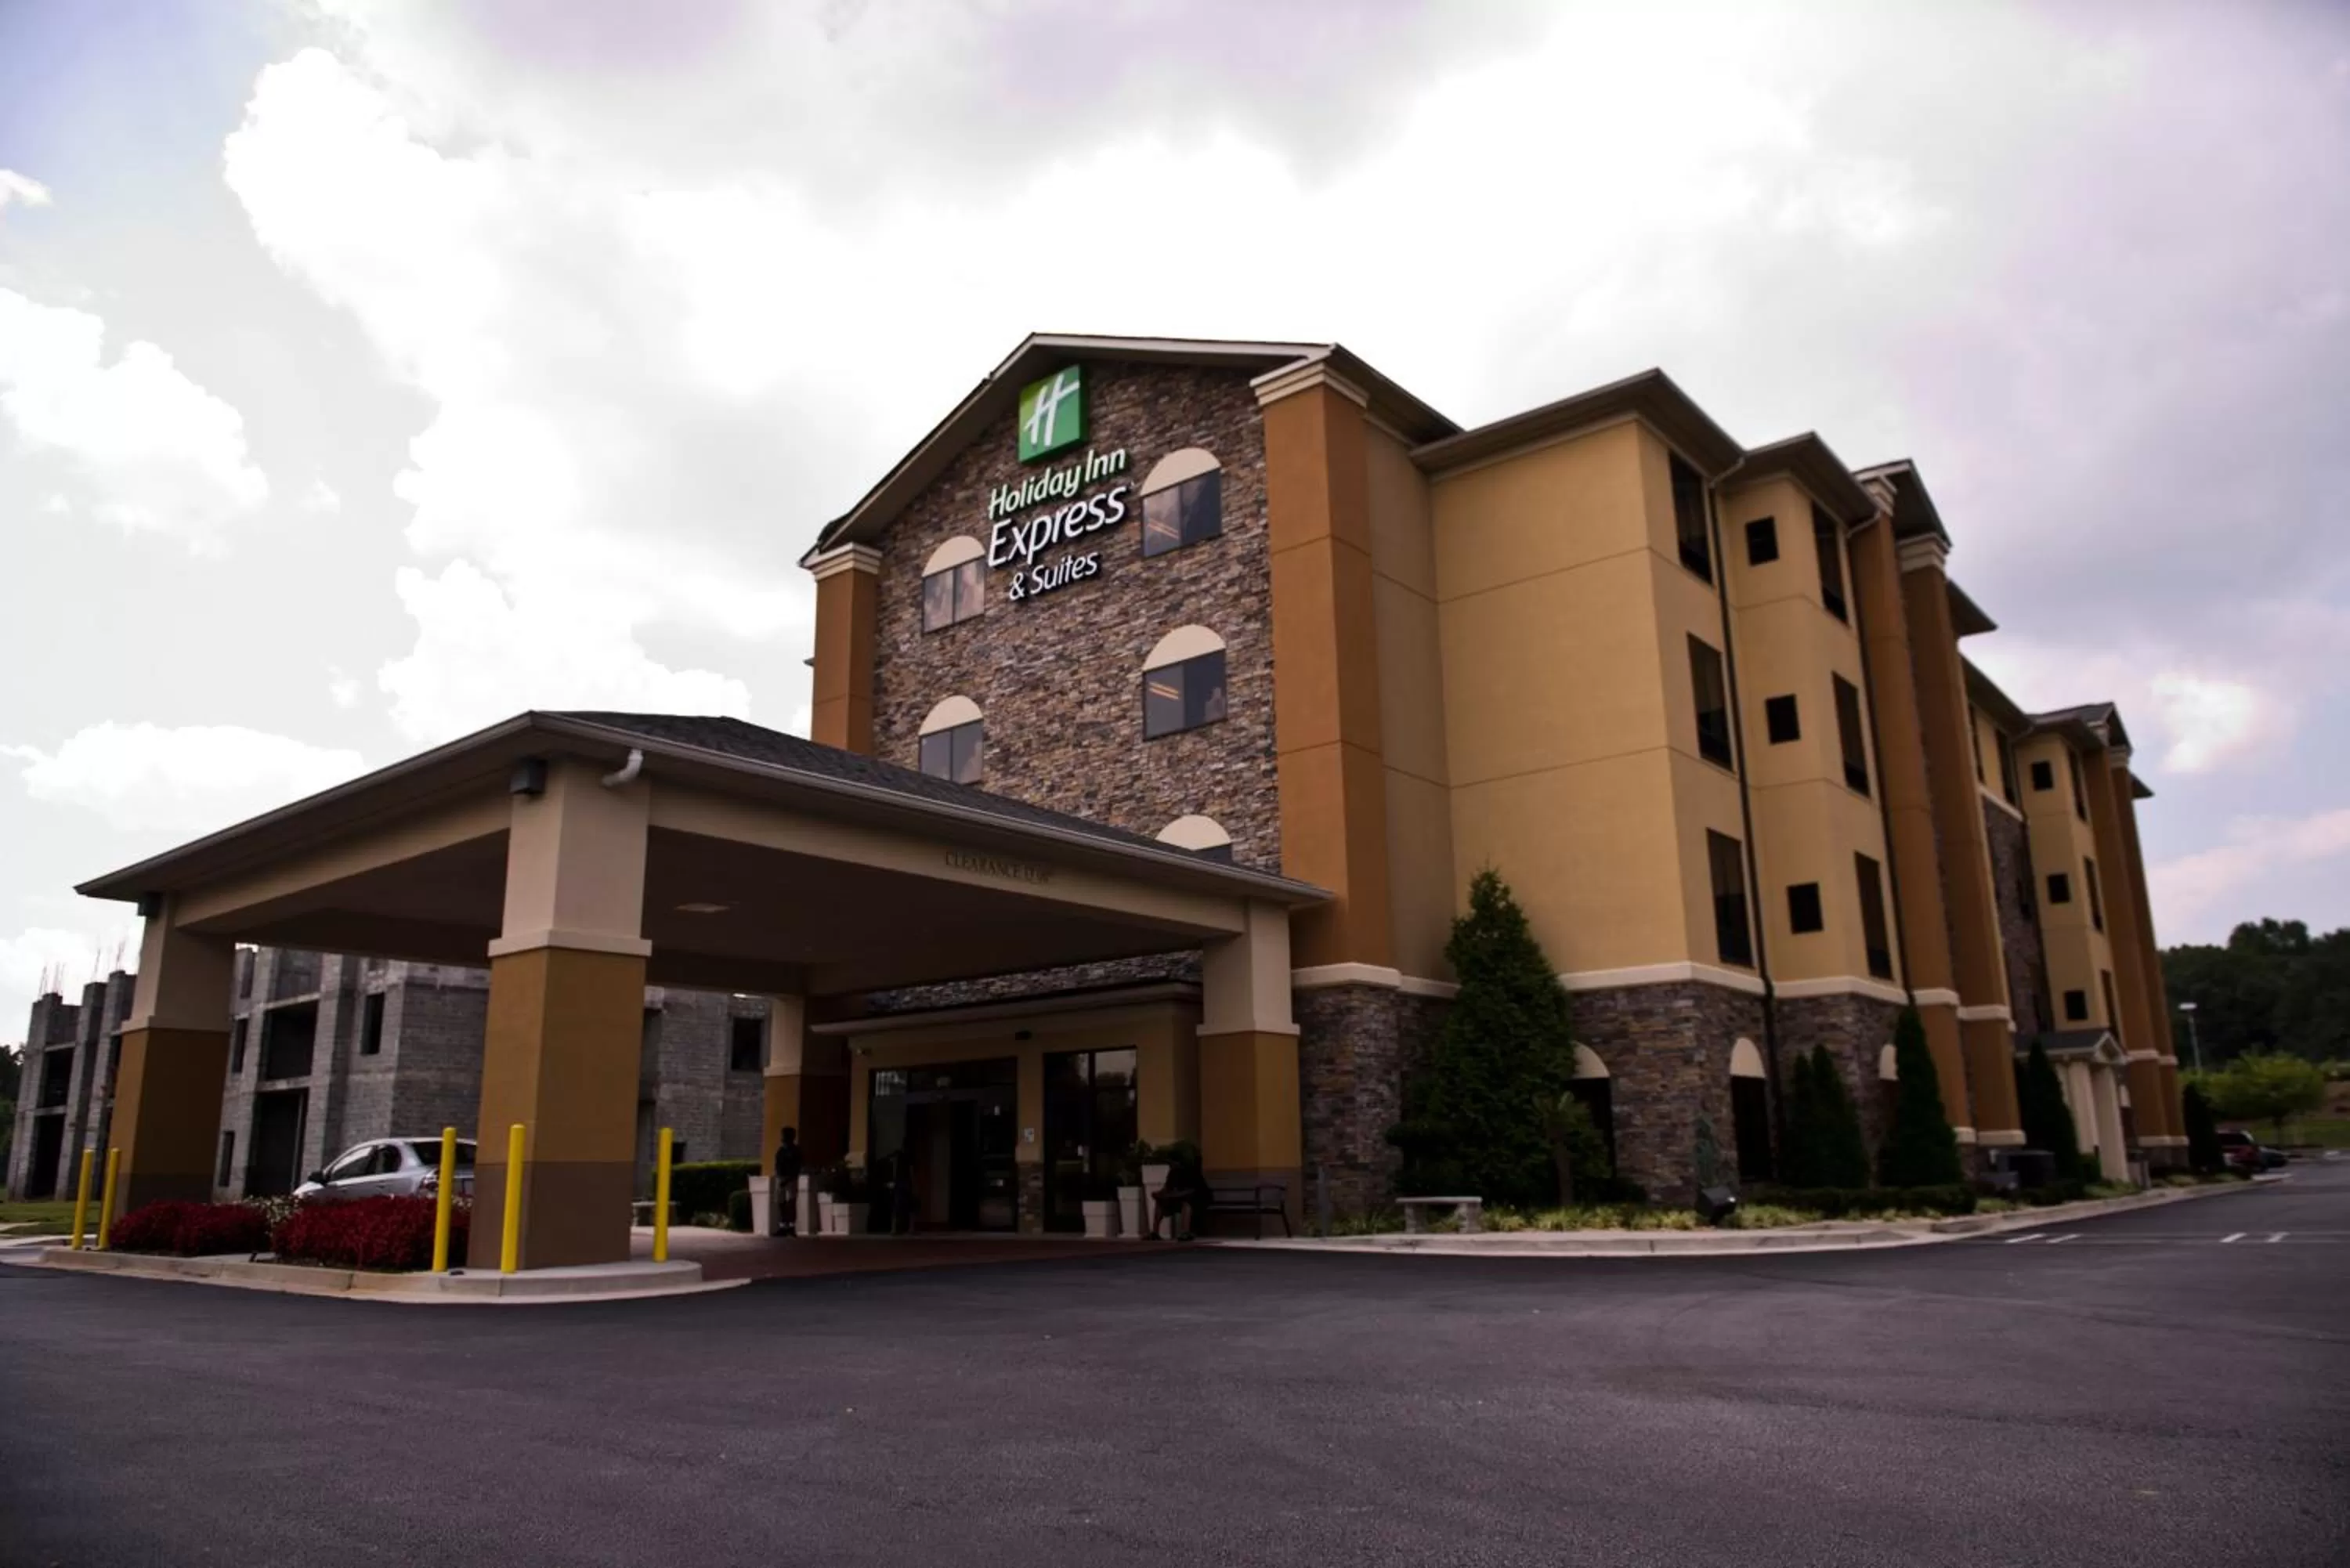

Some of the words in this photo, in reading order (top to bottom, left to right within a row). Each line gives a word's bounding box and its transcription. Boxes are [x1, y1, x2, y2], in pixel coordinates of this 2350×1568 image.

[988, 464, 1081, 520] Holiday
[1085, 448, 1126, 482] Inn
[988, 486, 1128, 567] Express
[1009, 572, 1025, 600] &
[1030, 551, 1099, 594] Suites
